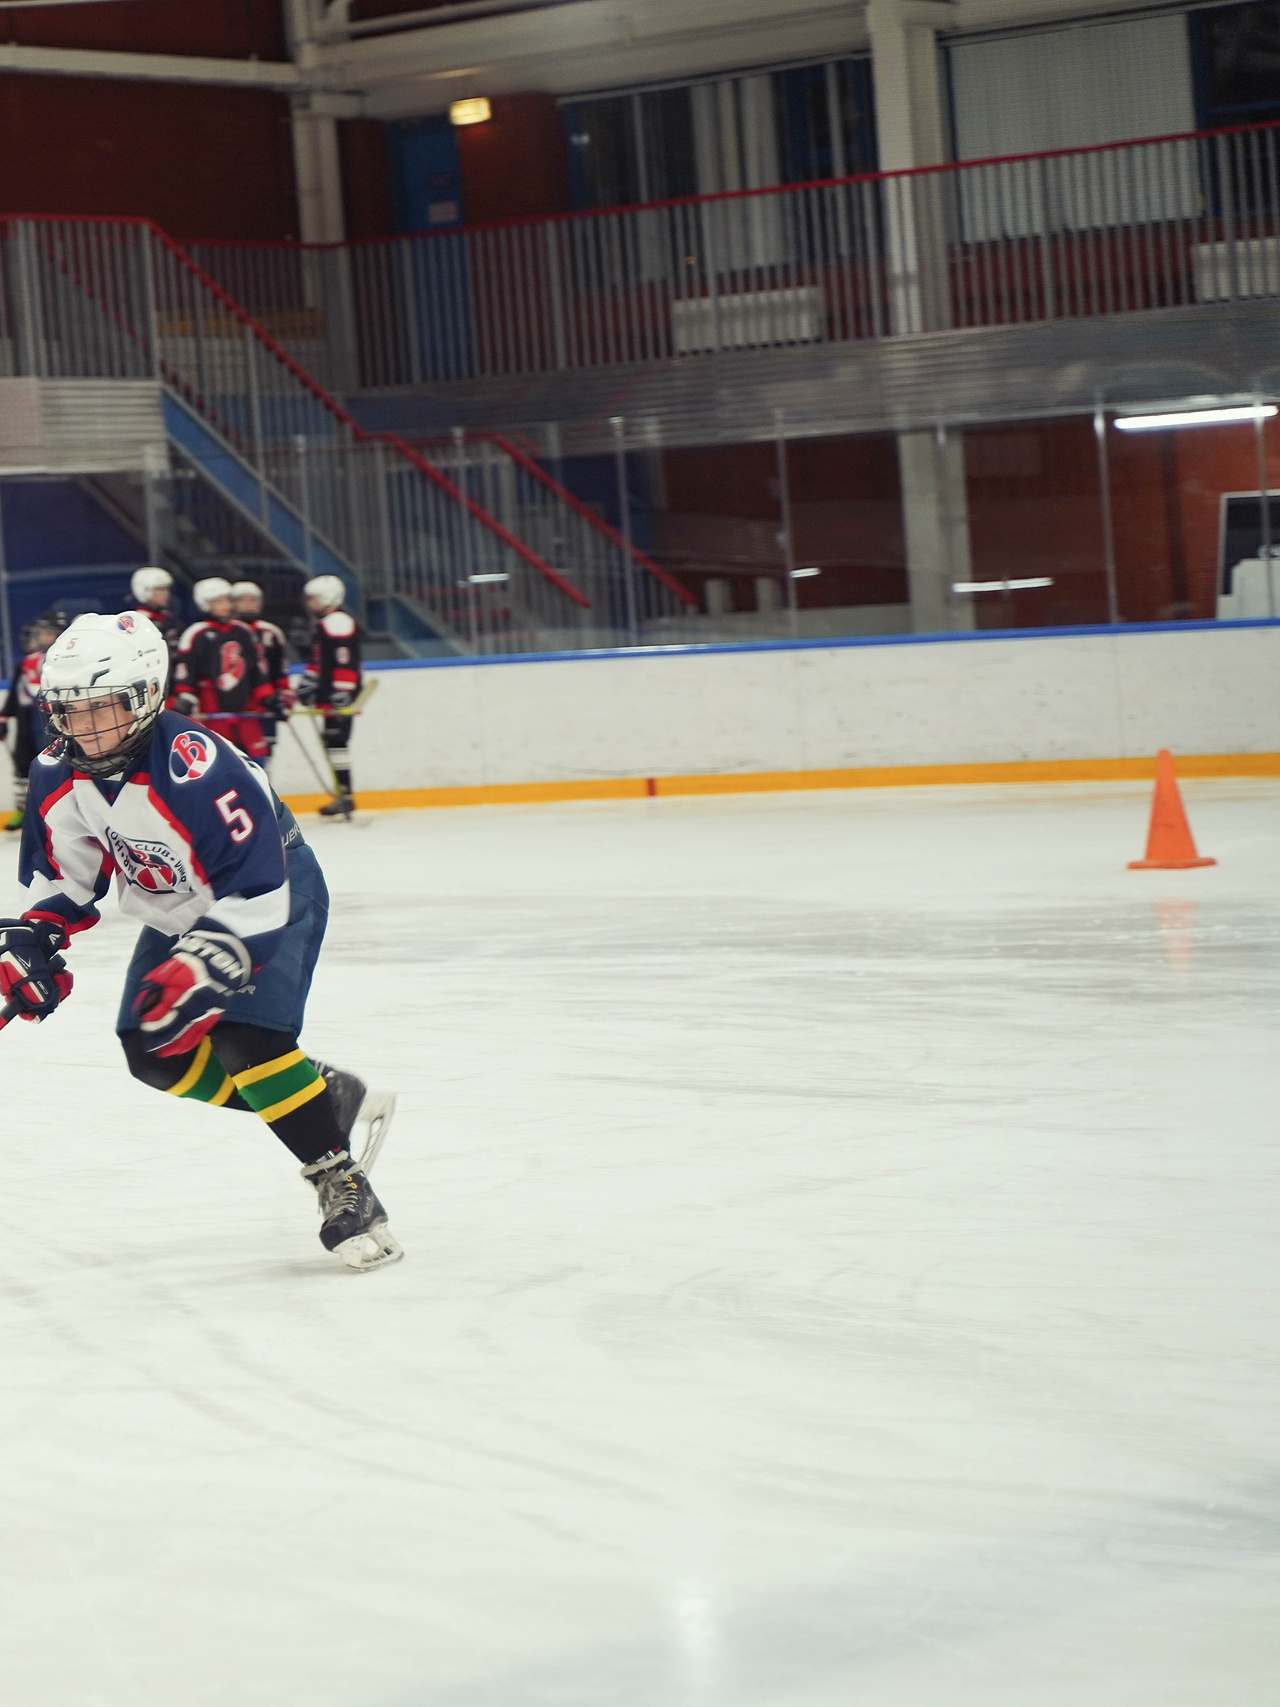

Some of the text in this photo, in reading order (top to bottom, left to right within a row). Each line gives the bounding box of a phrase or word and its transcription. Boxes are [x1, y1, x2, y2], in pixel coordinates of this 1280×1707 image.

[66, 637, 79, 650] 5
[214, 788, 254, 844] 5
[134, 843, 171, 858] CLUB
